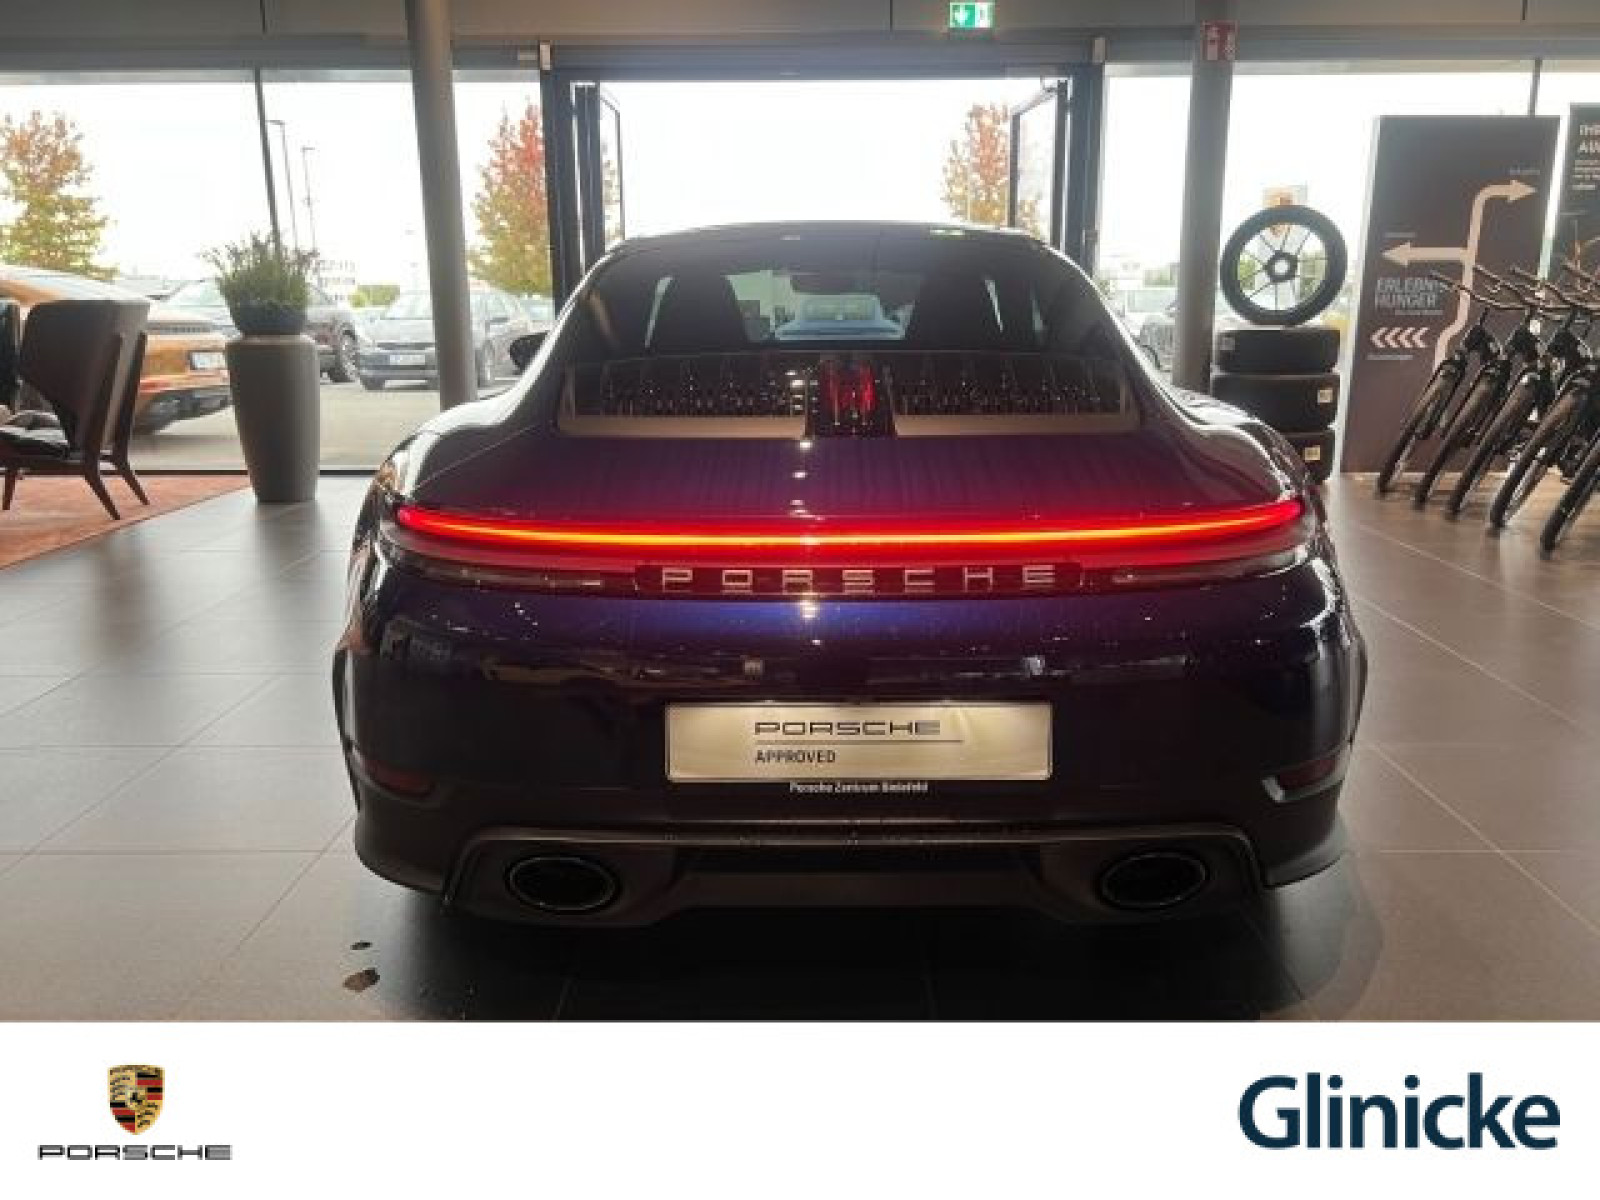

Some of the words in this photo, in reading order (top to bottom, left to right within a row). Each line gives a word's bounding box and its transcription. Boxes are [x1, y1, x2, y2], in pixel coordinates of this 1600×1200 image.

[661, 565, 1056, 590] PORSCHE
[754, 721, 941, 735] PORSCHE
[755, 749, 836, 763] APPROVED
